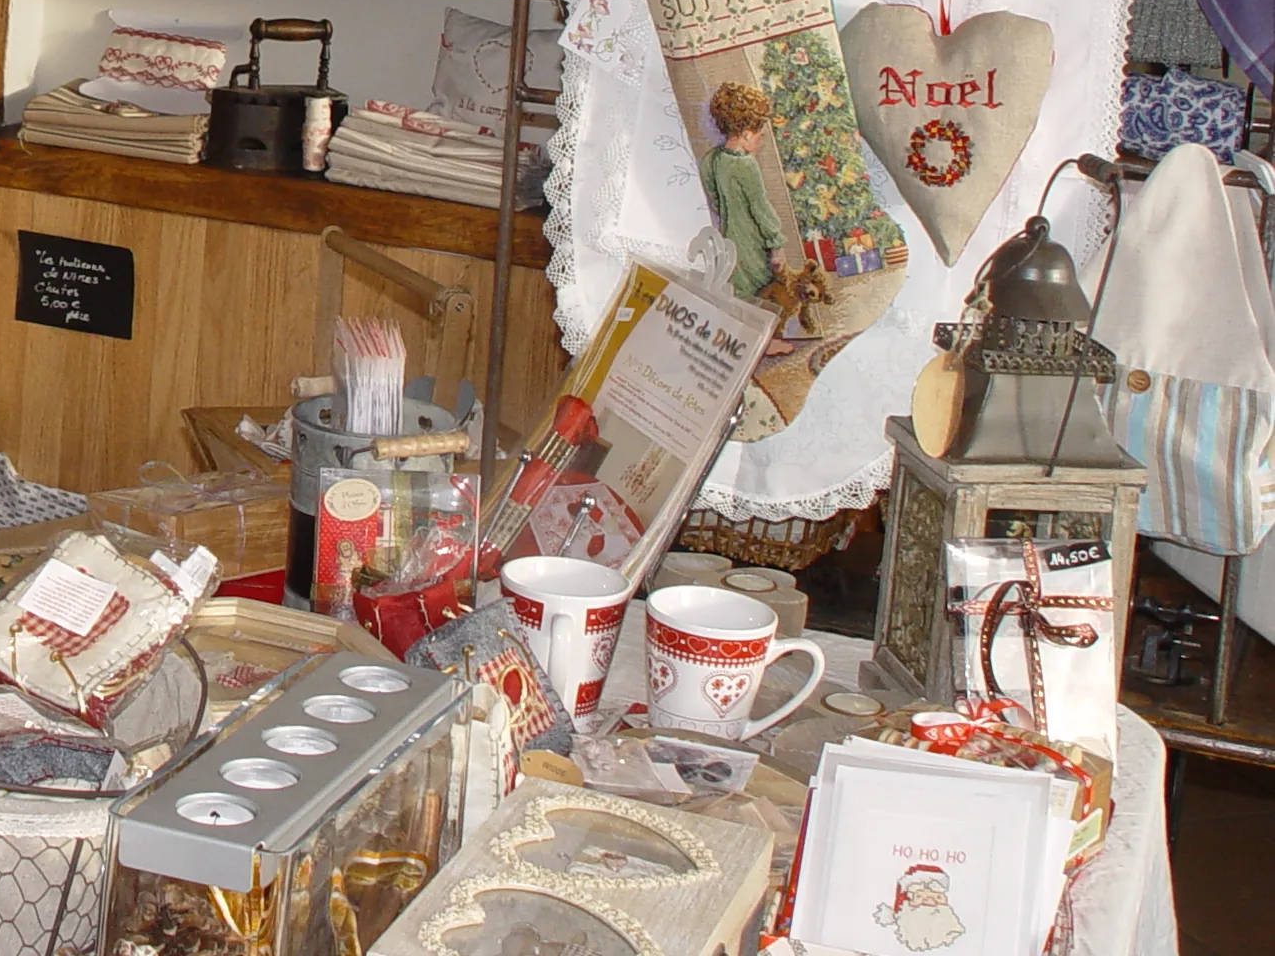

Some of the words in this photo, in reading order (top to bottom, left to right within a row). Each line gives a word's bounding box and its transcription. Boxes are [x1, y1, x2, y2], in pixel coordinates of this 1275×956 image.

[877, 66, 1004, 109] Noël
[656, 294, 698, 329] DUOS
[695, 320, 711, 341] de
[711, 328, 747, 360] DMC
[1050, 546, 1100, 566] 14,50€
[892, 844, 913, 859] HO
[919, 848, 940, 862] HO
[946, 851, 967, 864] HO
